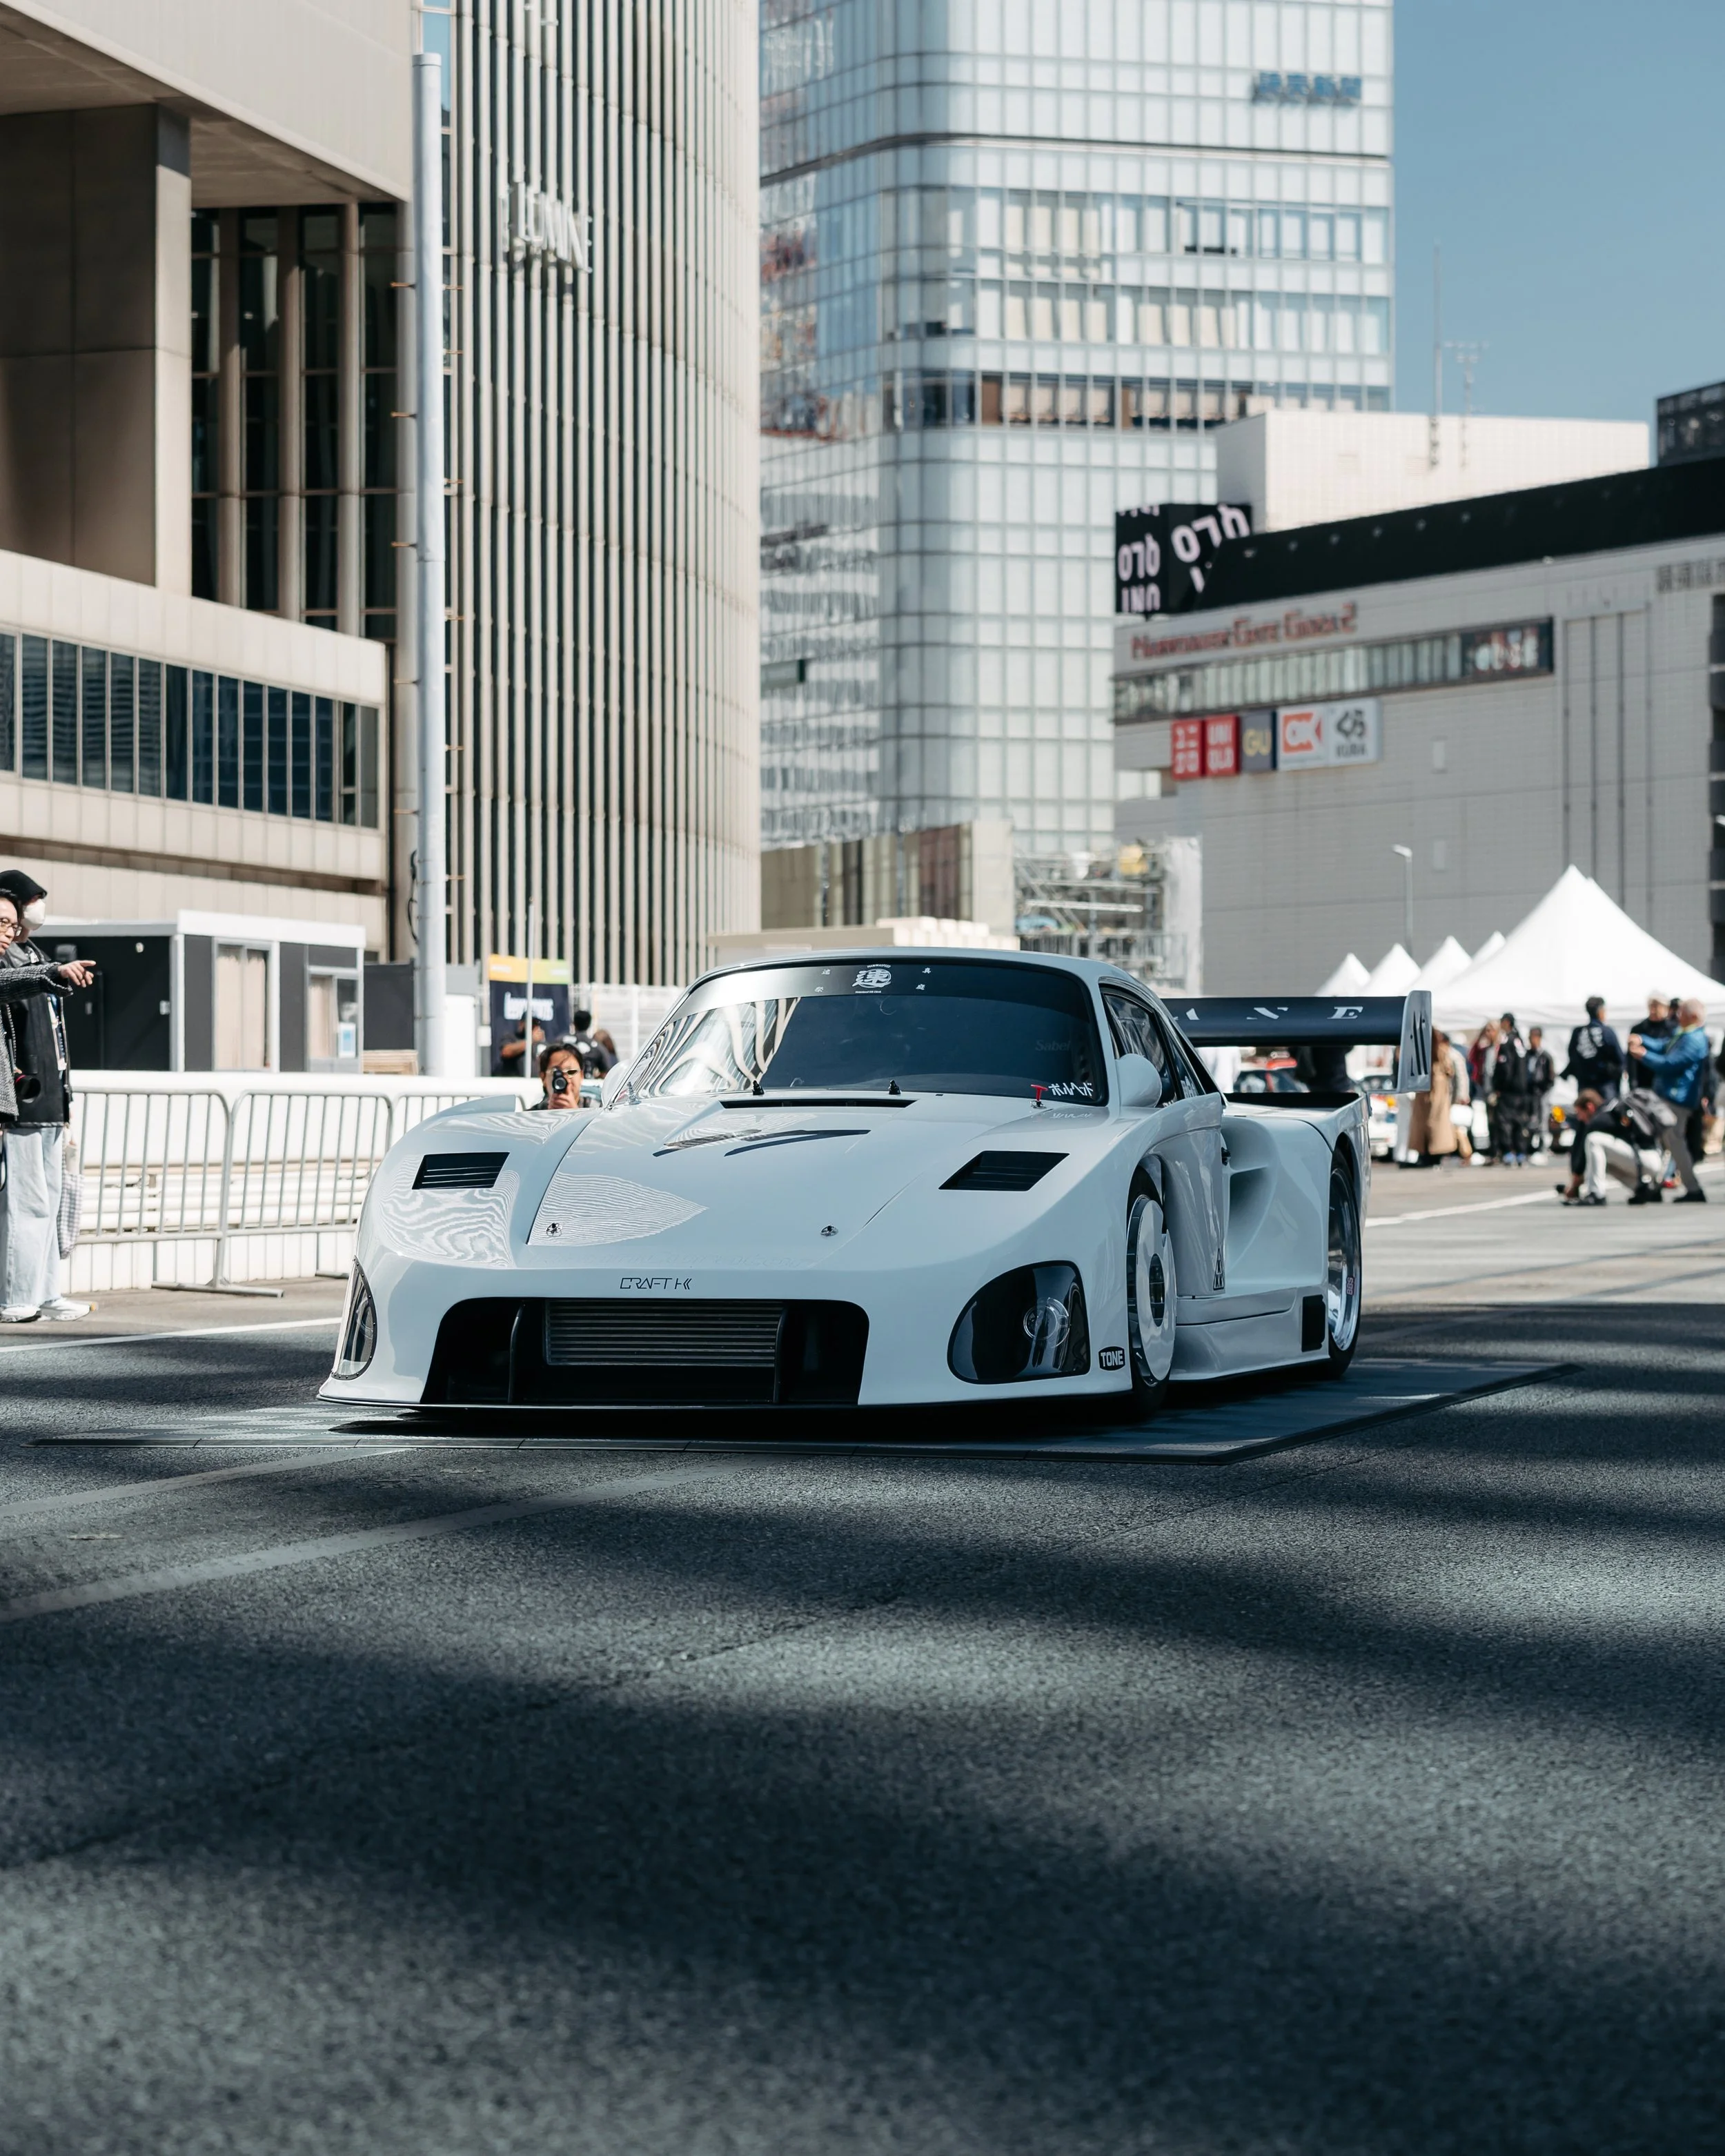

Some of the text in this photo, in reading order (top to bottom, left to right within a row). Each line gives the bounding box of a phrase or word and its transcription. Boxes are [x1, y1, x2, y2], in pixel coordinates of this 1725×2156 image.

[1243, 729, 1272, 757] GU
[620, 1277, 673, 1289] CRAFT
[1101, 1350, 1123, 1367] TONE
